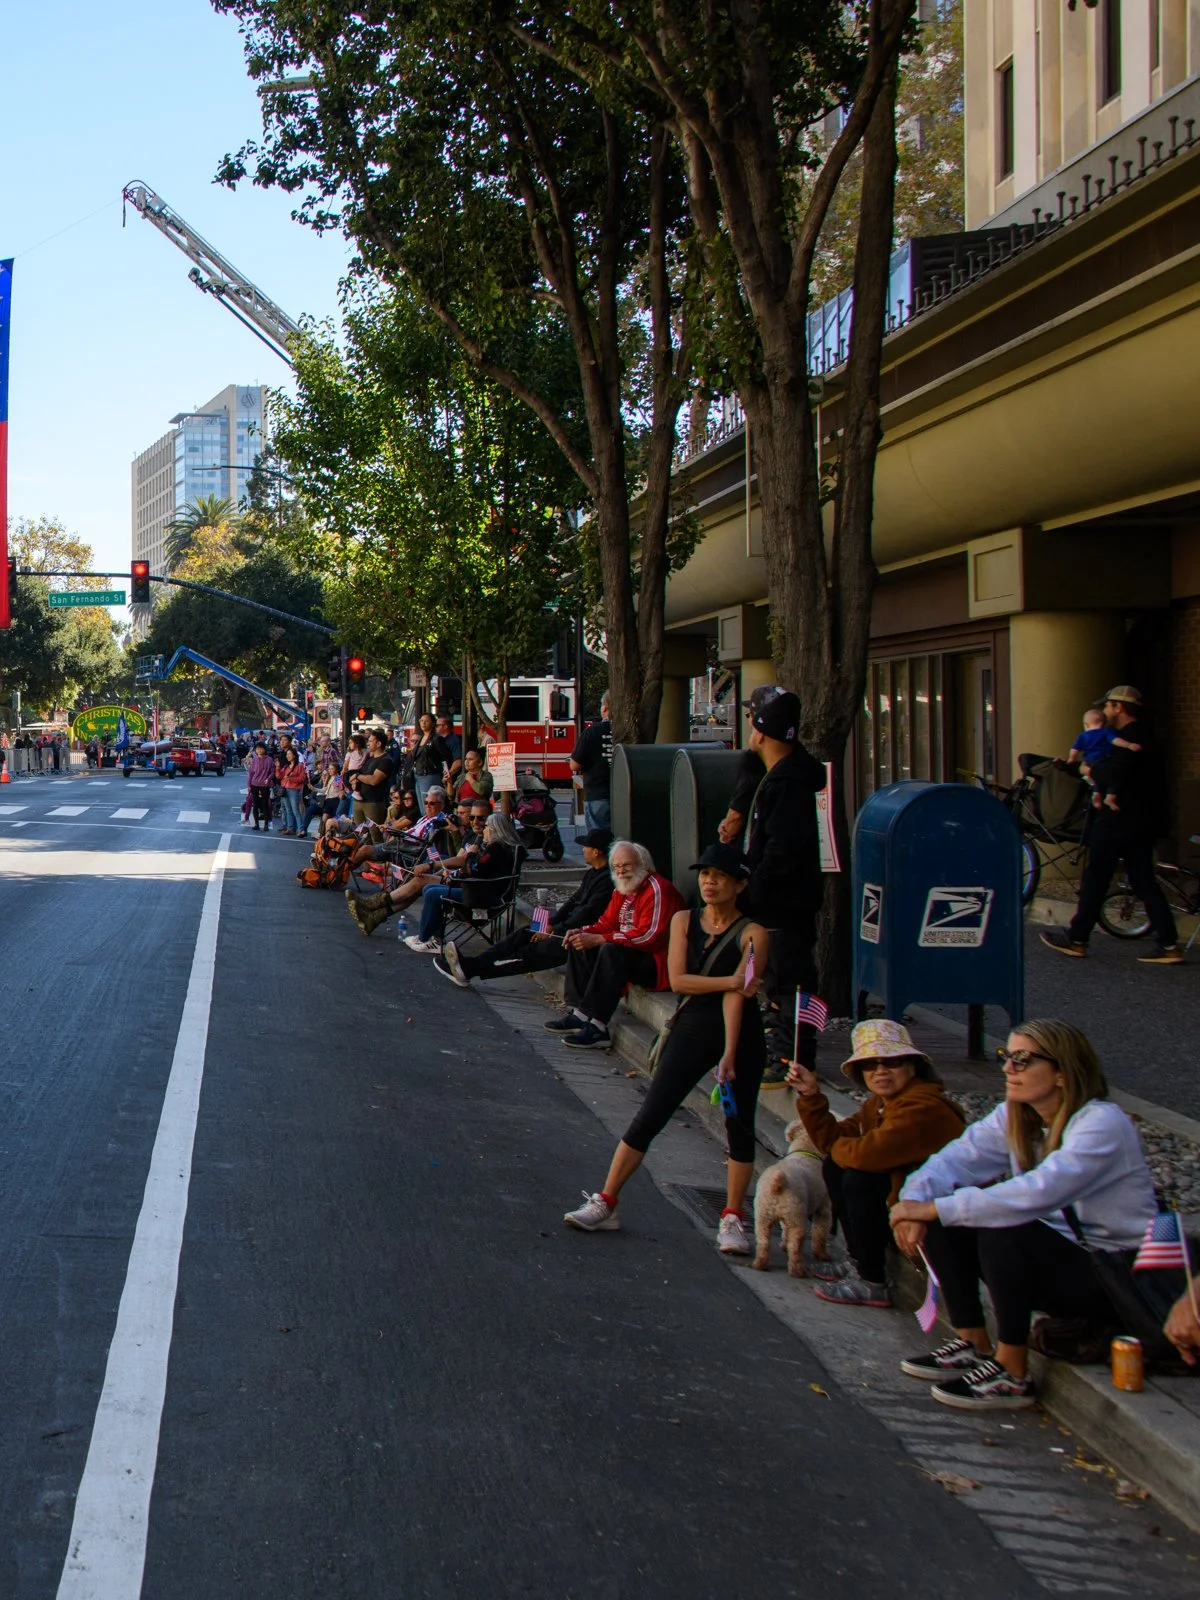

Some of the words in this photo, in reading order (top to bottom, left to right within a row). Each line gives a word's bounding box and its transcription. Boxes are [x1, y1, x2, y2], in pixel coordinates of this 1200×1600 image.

[51, 596, 68, 604] San
[70, 595, 110, 603] Fernando
[113, 594, 123, 602] St
[554, 728, 567, 737] T-1
[488, 756, 498, 767] NO
